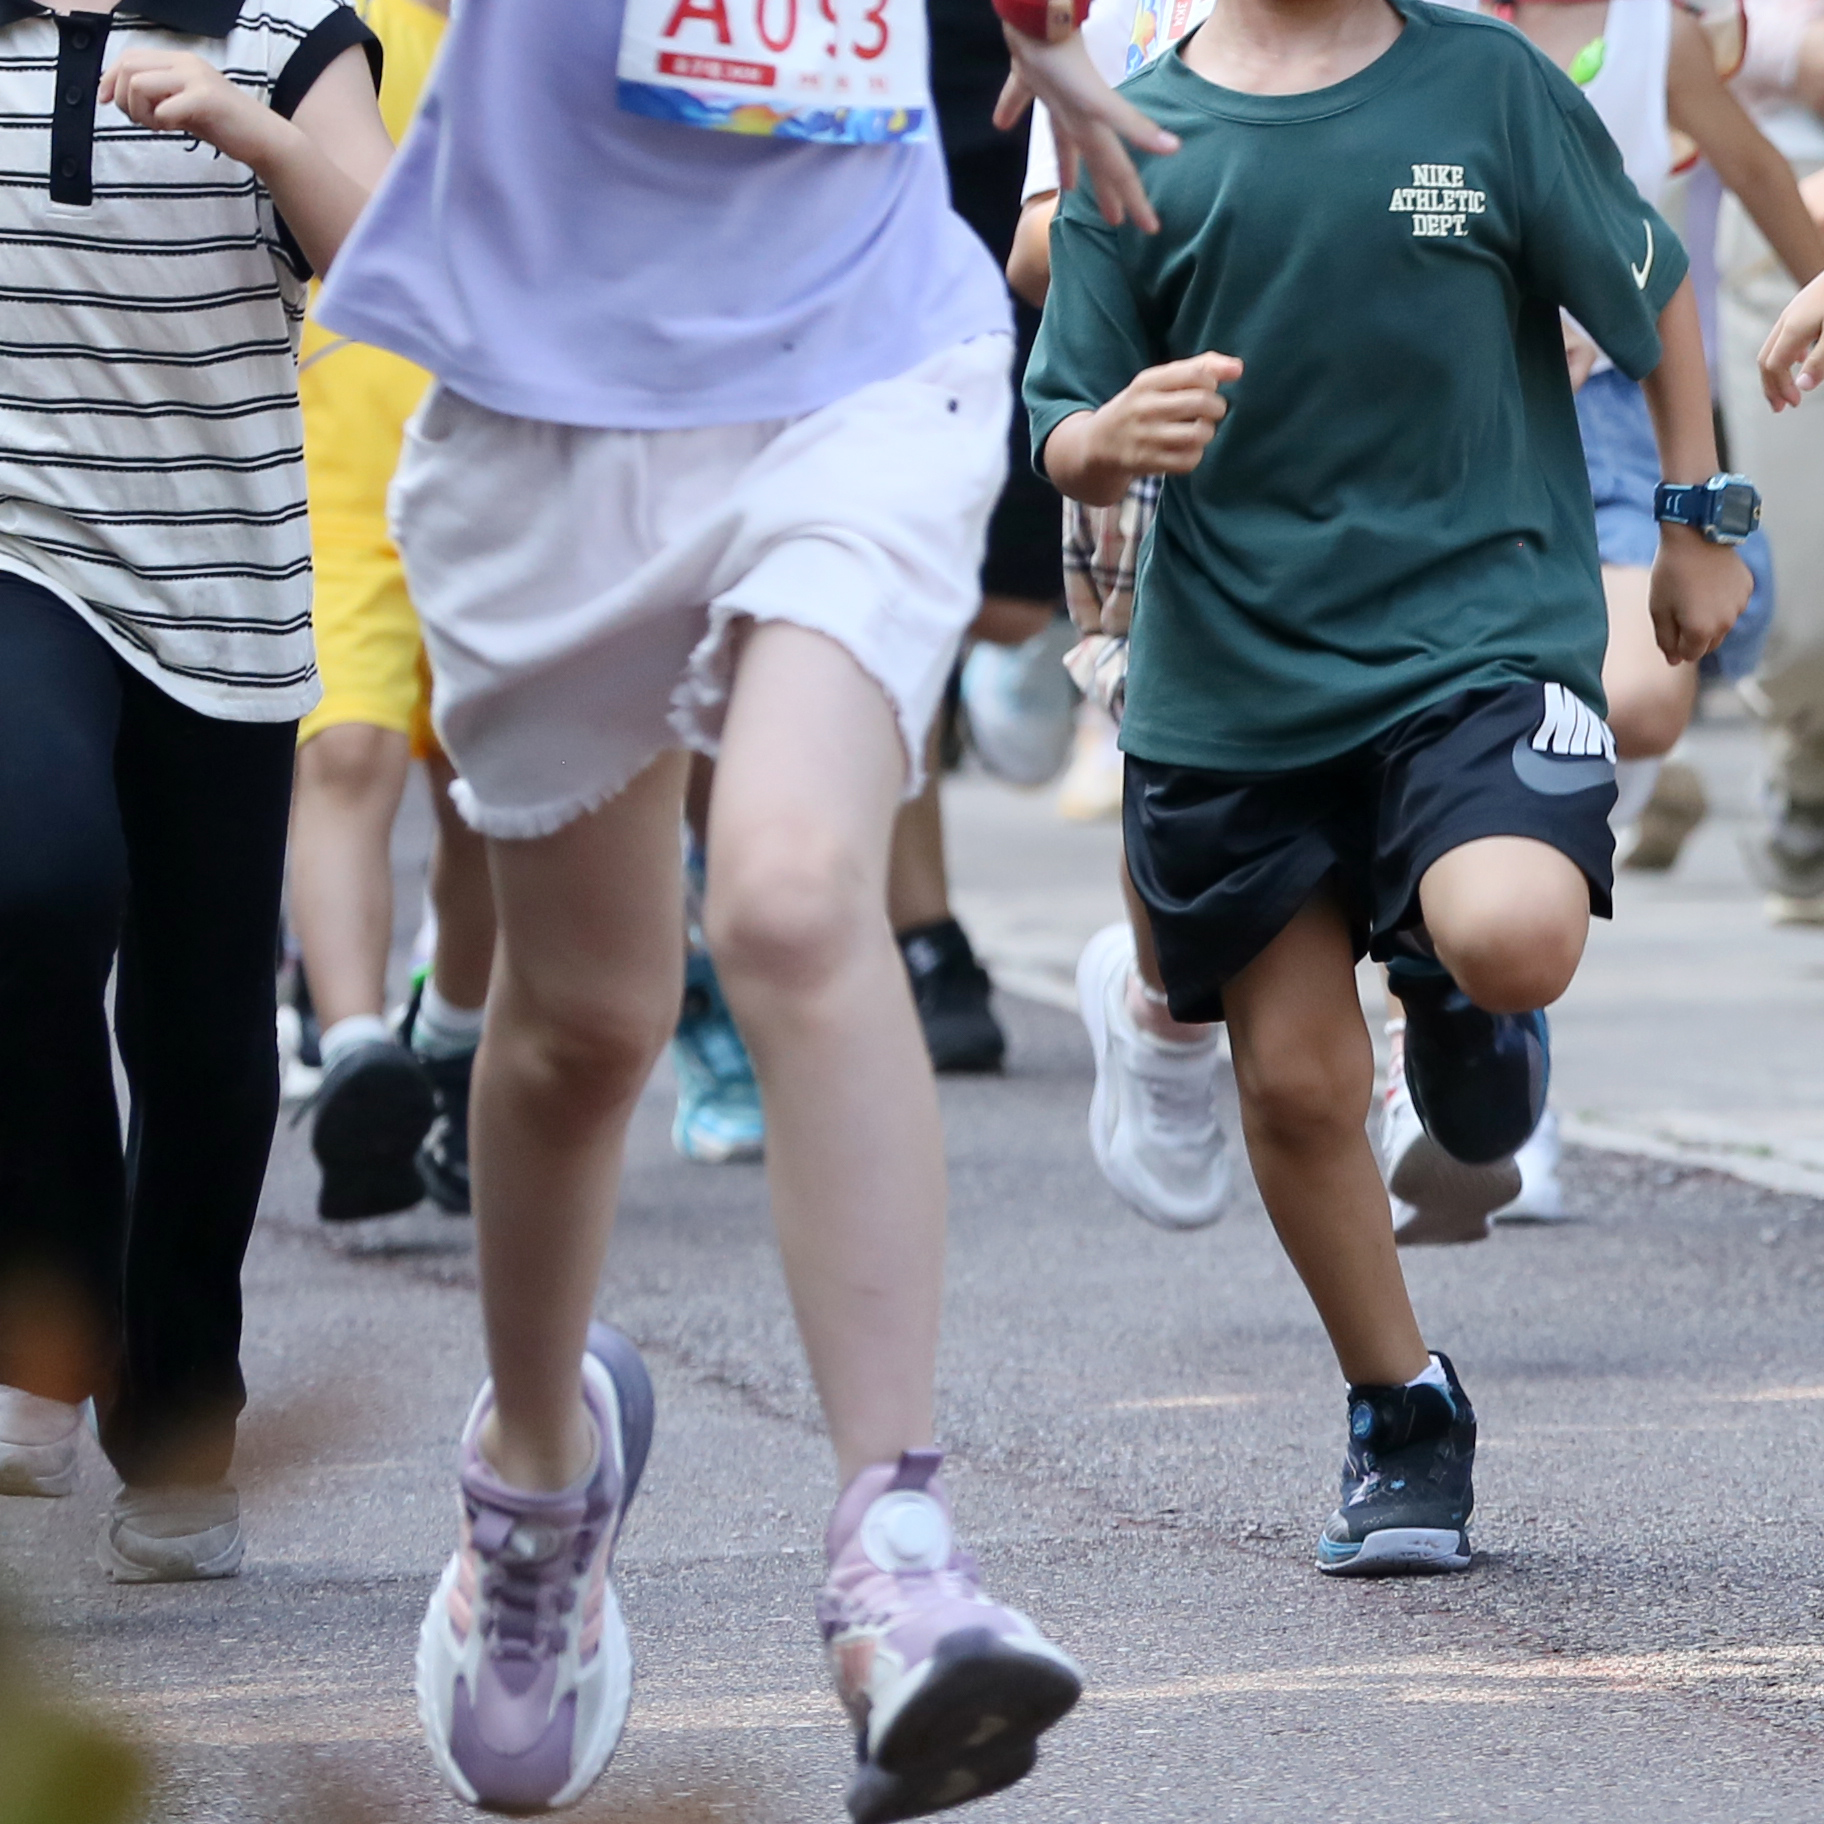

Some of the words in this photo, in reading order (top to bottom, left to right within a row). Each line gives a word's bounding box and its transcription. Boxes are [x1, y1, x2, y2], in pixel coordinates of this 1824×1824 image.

[1410, 164, 1465, 188] NIKE
[1388, 187, 1487, 214] ATHLETIC
[1411, 213, 1470, 237] DEPT.
[1532, 682, 1617, 765] NIK
